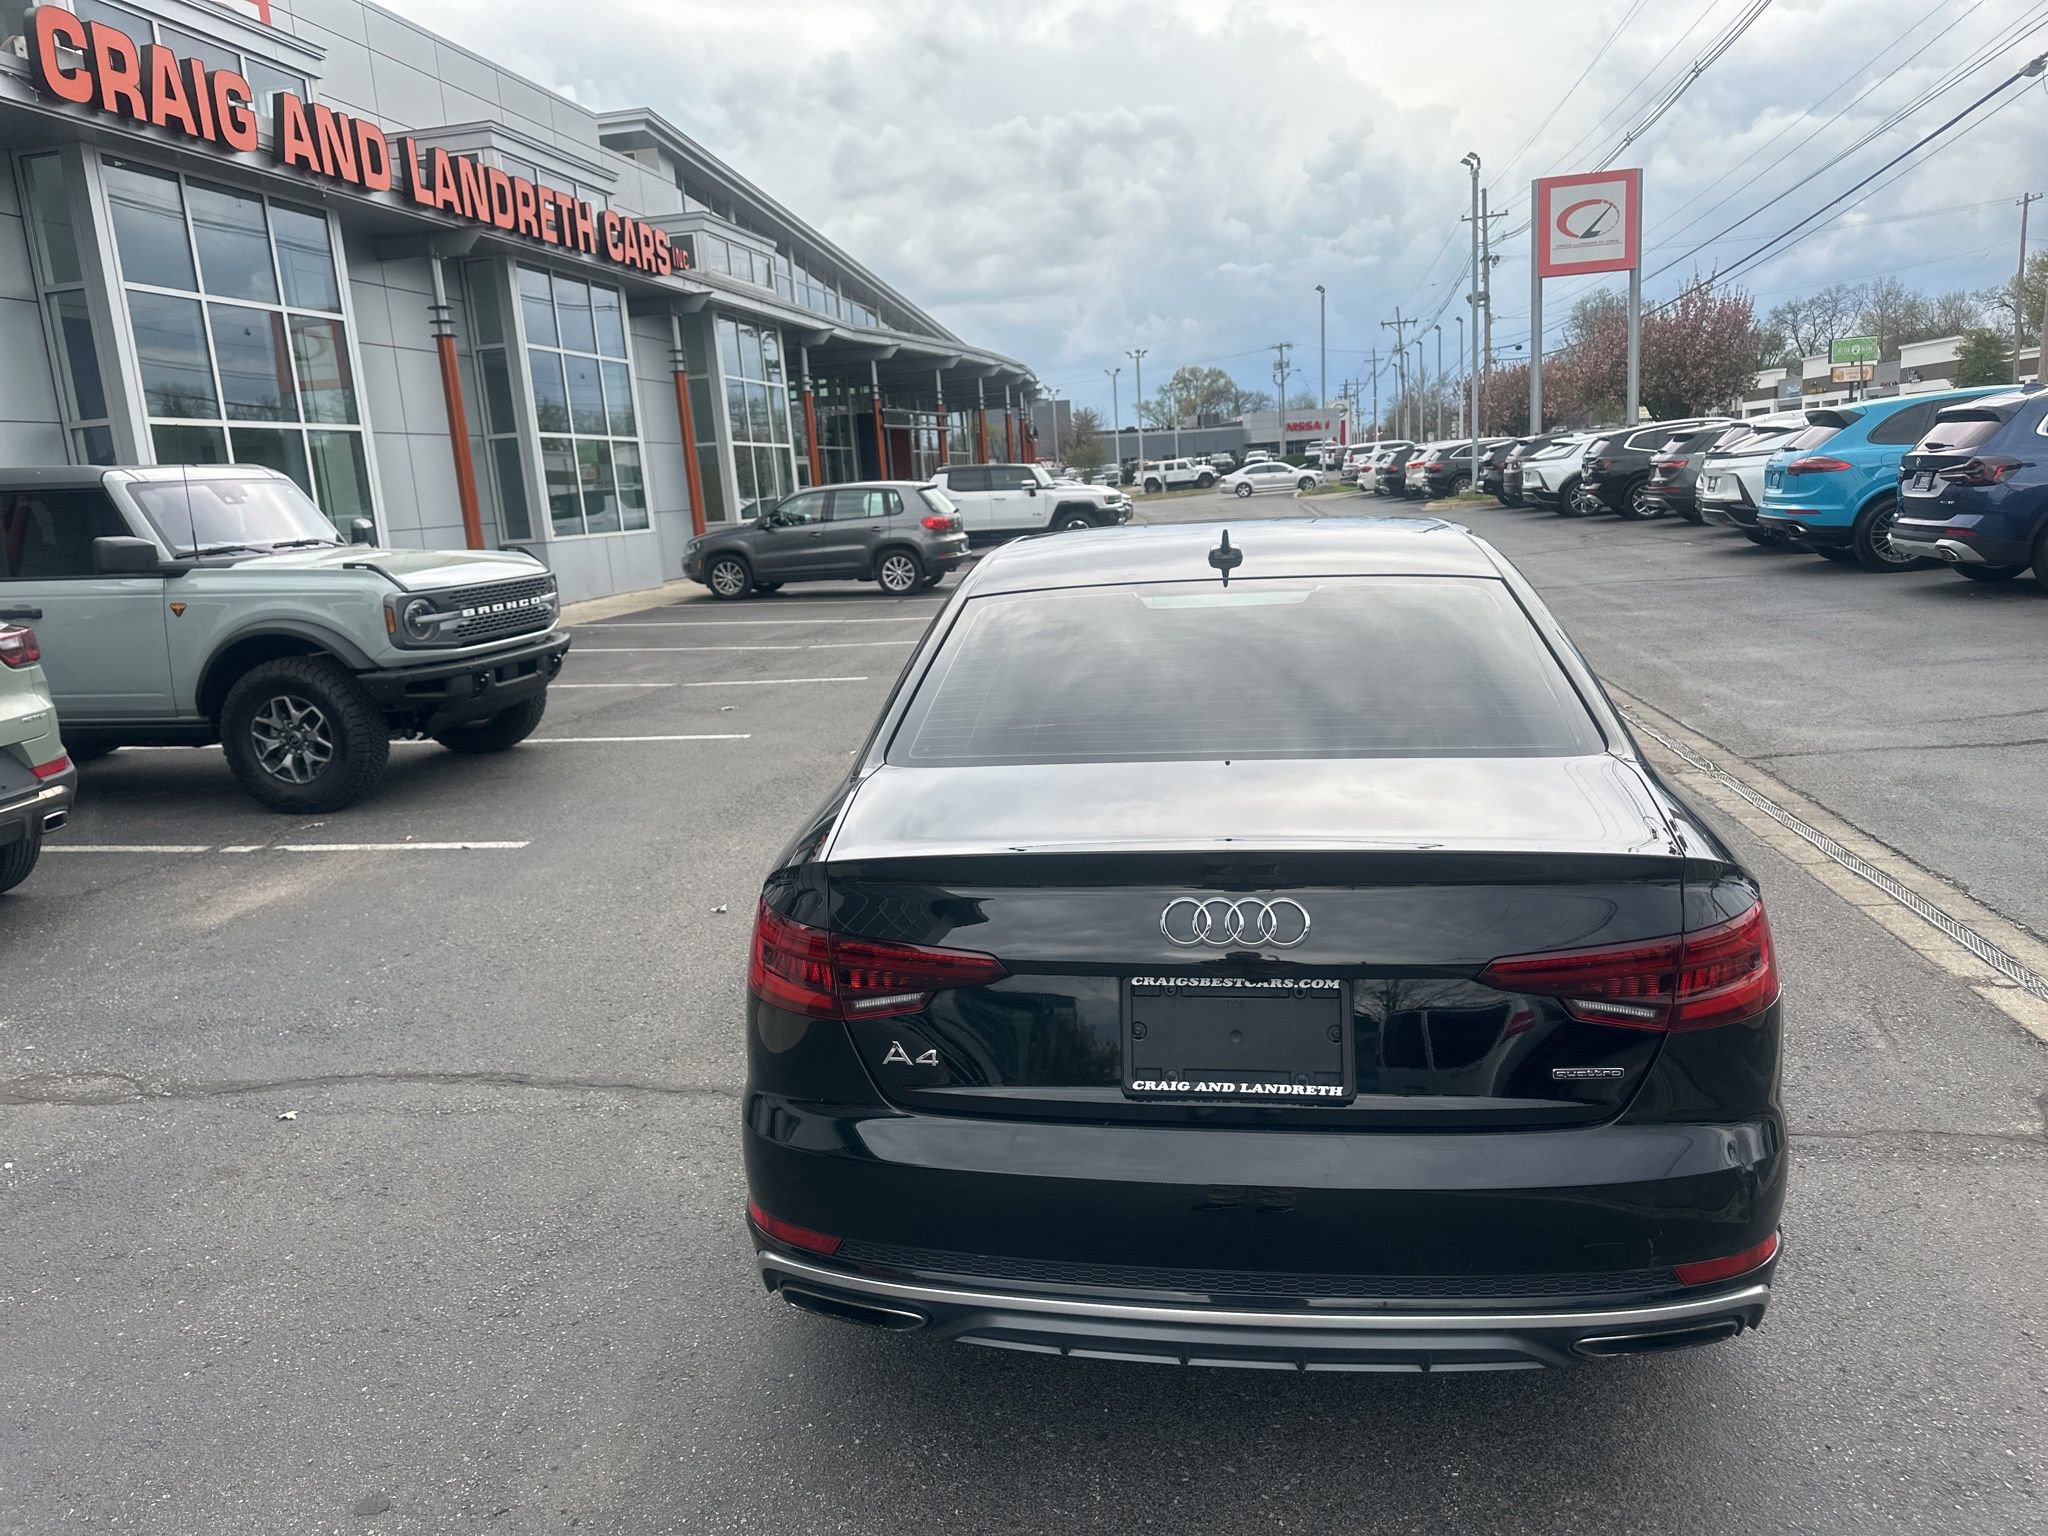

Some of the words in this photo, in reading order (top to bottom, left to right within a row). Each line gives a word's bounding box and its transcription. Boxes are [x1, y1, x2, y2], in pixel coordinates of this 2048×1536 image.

[33, 5, 258, 152] CRAIG
[281, 93, 391, 191] AND
[404, 137, 596, 254] LANDRETH
[602, 209, 672, 276] CARS
[672, 247, 689, 270] INC
[462, 597, 540, 617] BRONCO
[1131, 977, 1340, 989] CRAIGSBESTCARS.COM
[882, 1040, 939, 1067] A4
[1555, 1069, 1622, 1079] quattro
[1131, 1080, 1191, 1091] CRAIG
[1194, 1082, 1235, 1093] AND
[1240, 1083, 1343, 1096] LANDRETH
